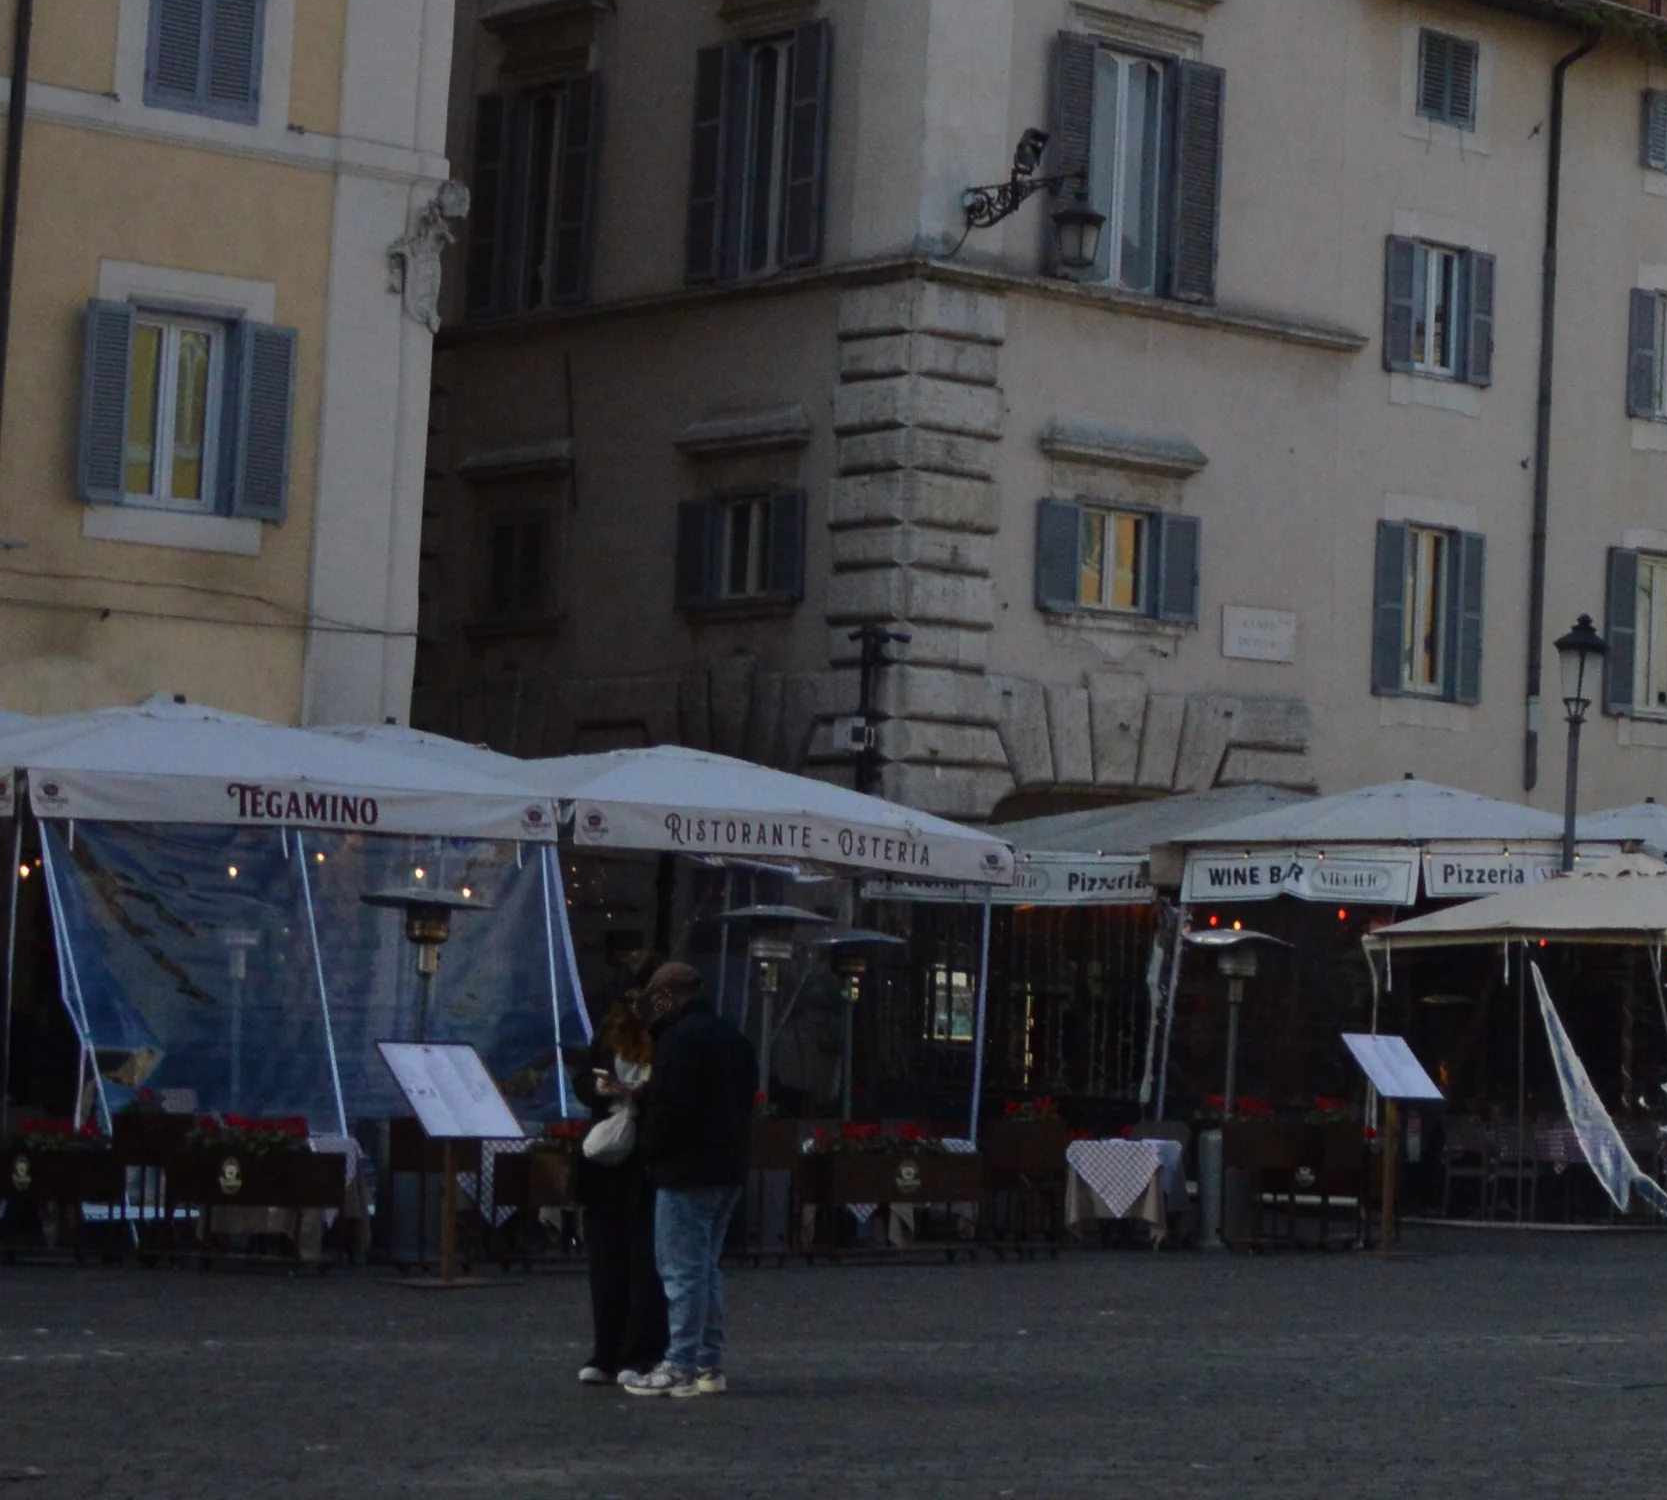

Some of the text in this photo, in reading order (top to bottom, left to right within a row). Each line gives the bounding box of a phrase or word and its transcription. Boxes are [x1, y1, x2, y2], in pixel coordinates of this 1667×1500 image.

[227, 783, 379, 825] TEGAMINO
[664, 812, 931, 866] RISTORANTE OSTERIA
[1208, 862, 1304, 887] WINE BAR
[1443, 863, 1525, 884] Pizzeria
